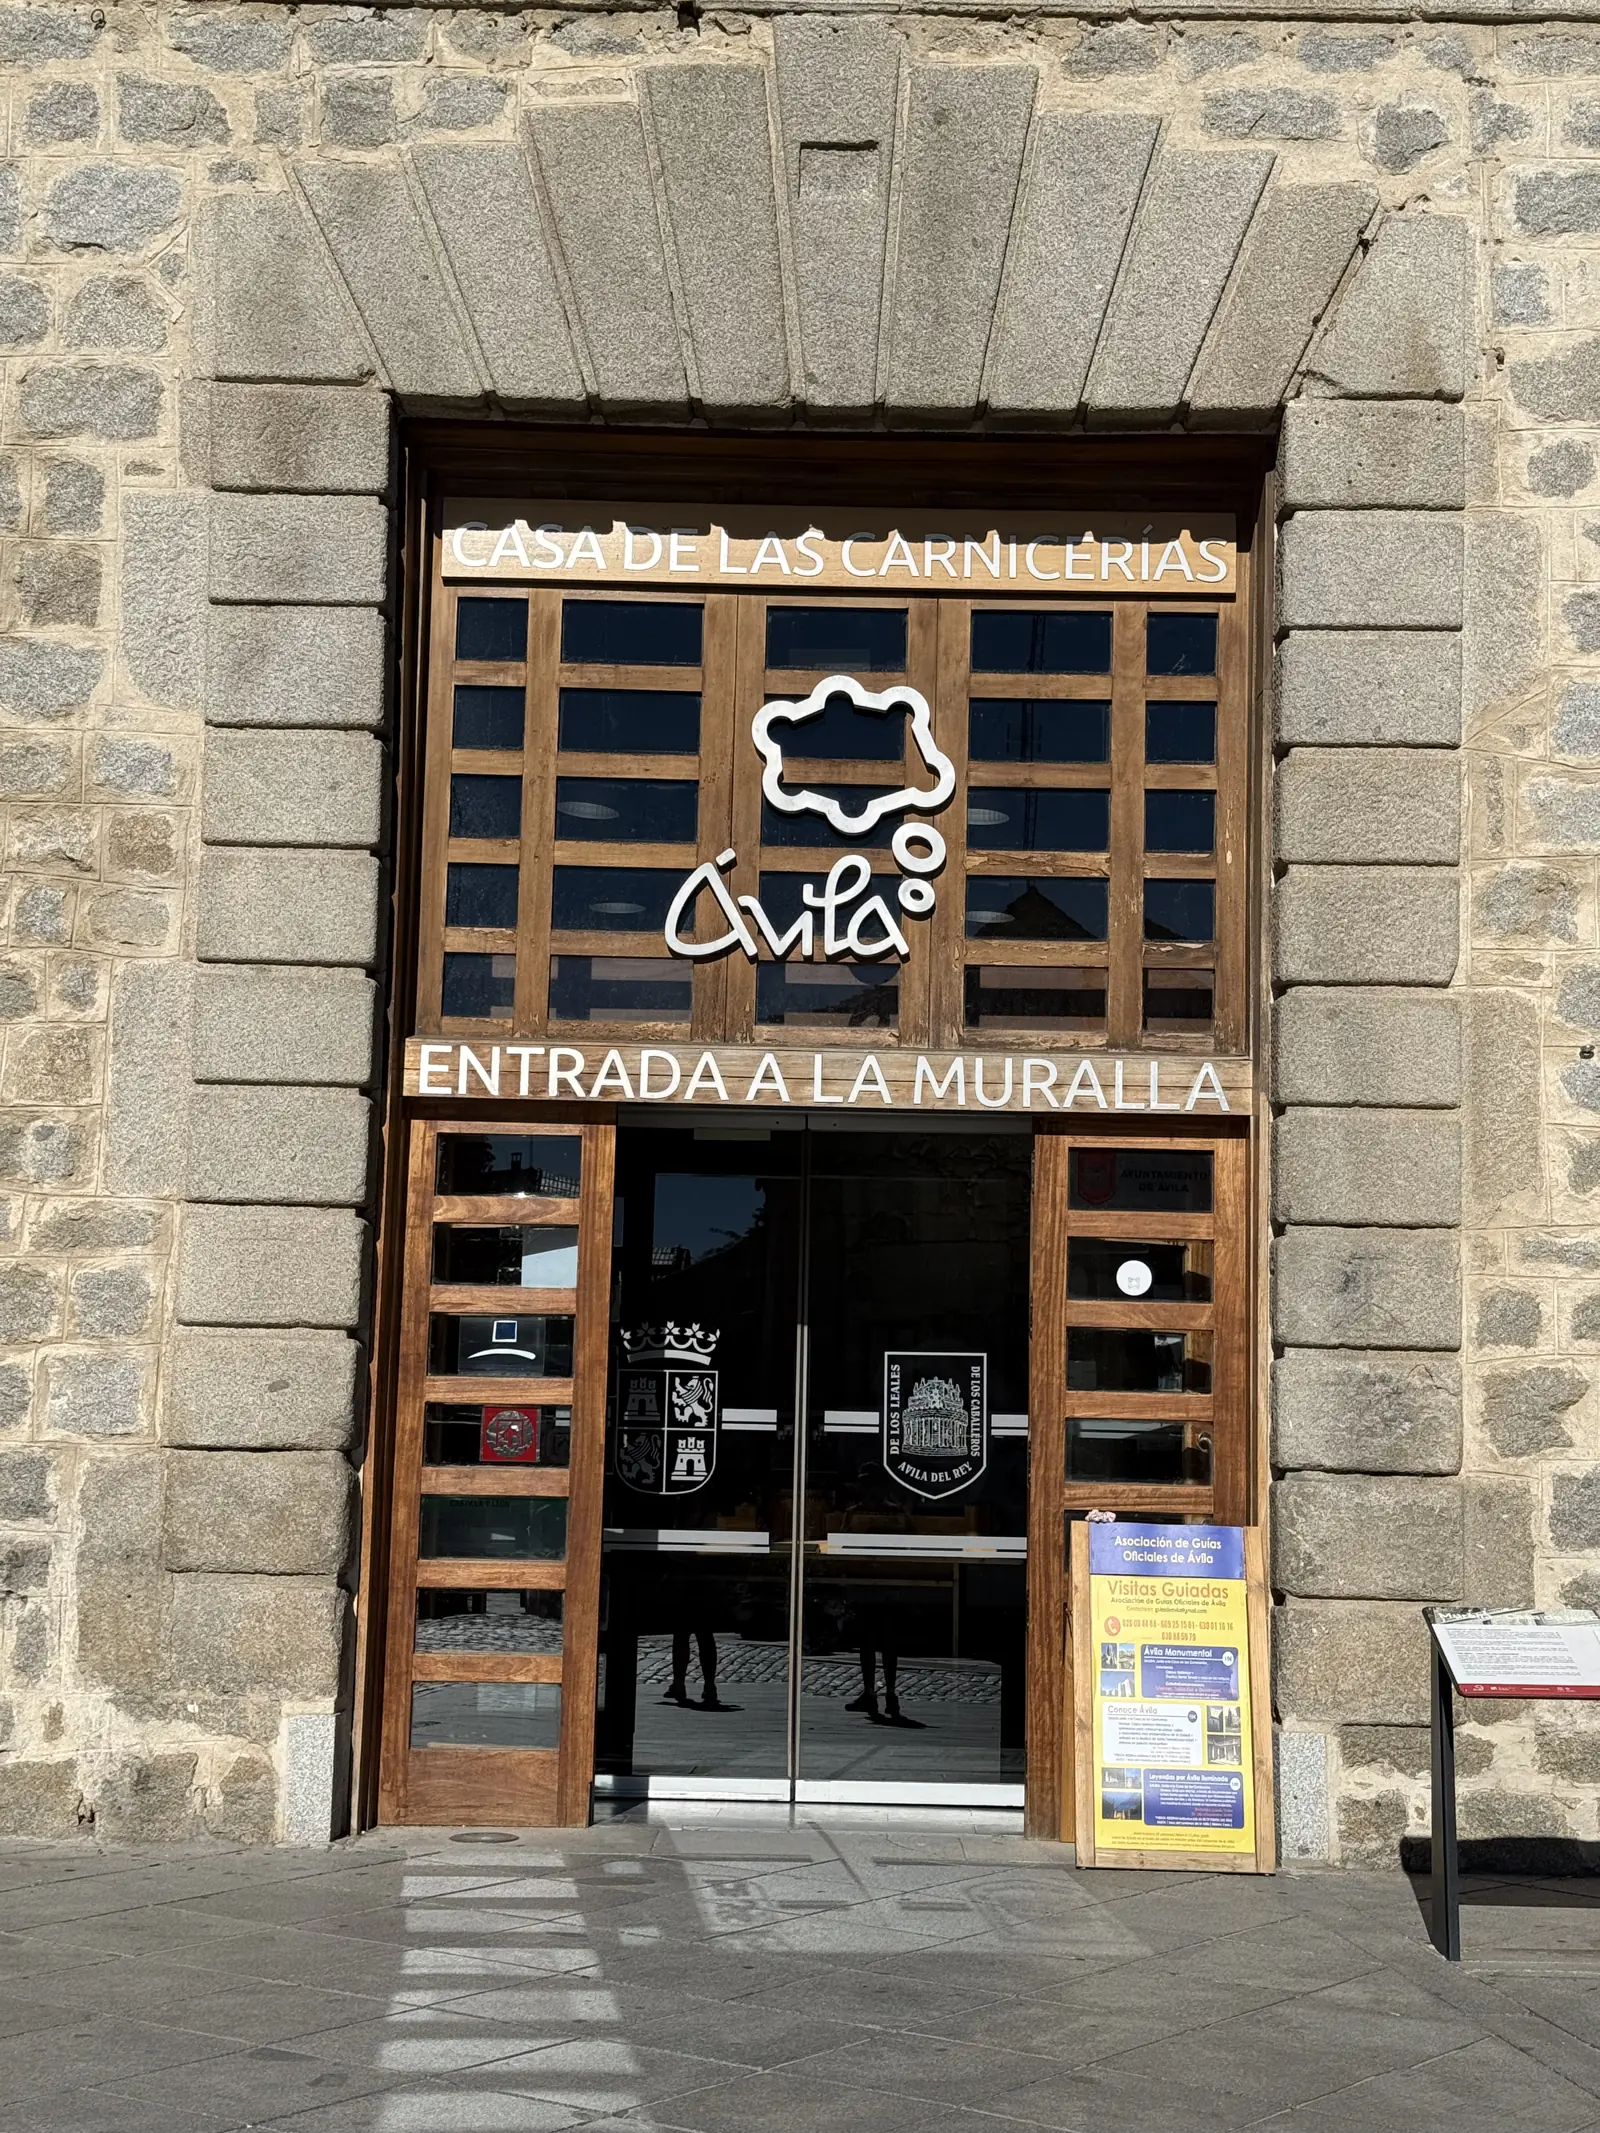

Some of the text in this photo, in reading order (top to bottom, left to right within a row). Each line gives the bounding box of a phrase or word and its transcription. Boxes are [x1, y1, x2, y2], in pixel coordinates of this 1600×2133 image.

[452, 521, 1228, 582] CASA DE LAS CARNICERÍAS
[664, 847, 910, 956] Ávila
[418, 1044, 1231, 1112] ENTRADA A LA MURALLA
[1120, 1168, 1208, 1181] AYUNTAMIENTO
[1138, 1182, 1155, 1192] DE
[890, 1364, 901, 1455] DE LOS LEALES
[971, 1366, 981, 1457] DE LOS CABALLEROS
[930, 1471, 951, 1482] DEL
[952, 1461, 973, 1479] REY
[1114, 1536, 1222, 1549] Asociación de Guías
[1123, 1550, 1214, 1563] Oficiales de Ávila
[1108, 1580, 1229, 1599] Visitas Guiadas
[1144, 1645, 1163, 1656] Ávila
[1107, 1704, 1158, 1714] Conoce Ávila
